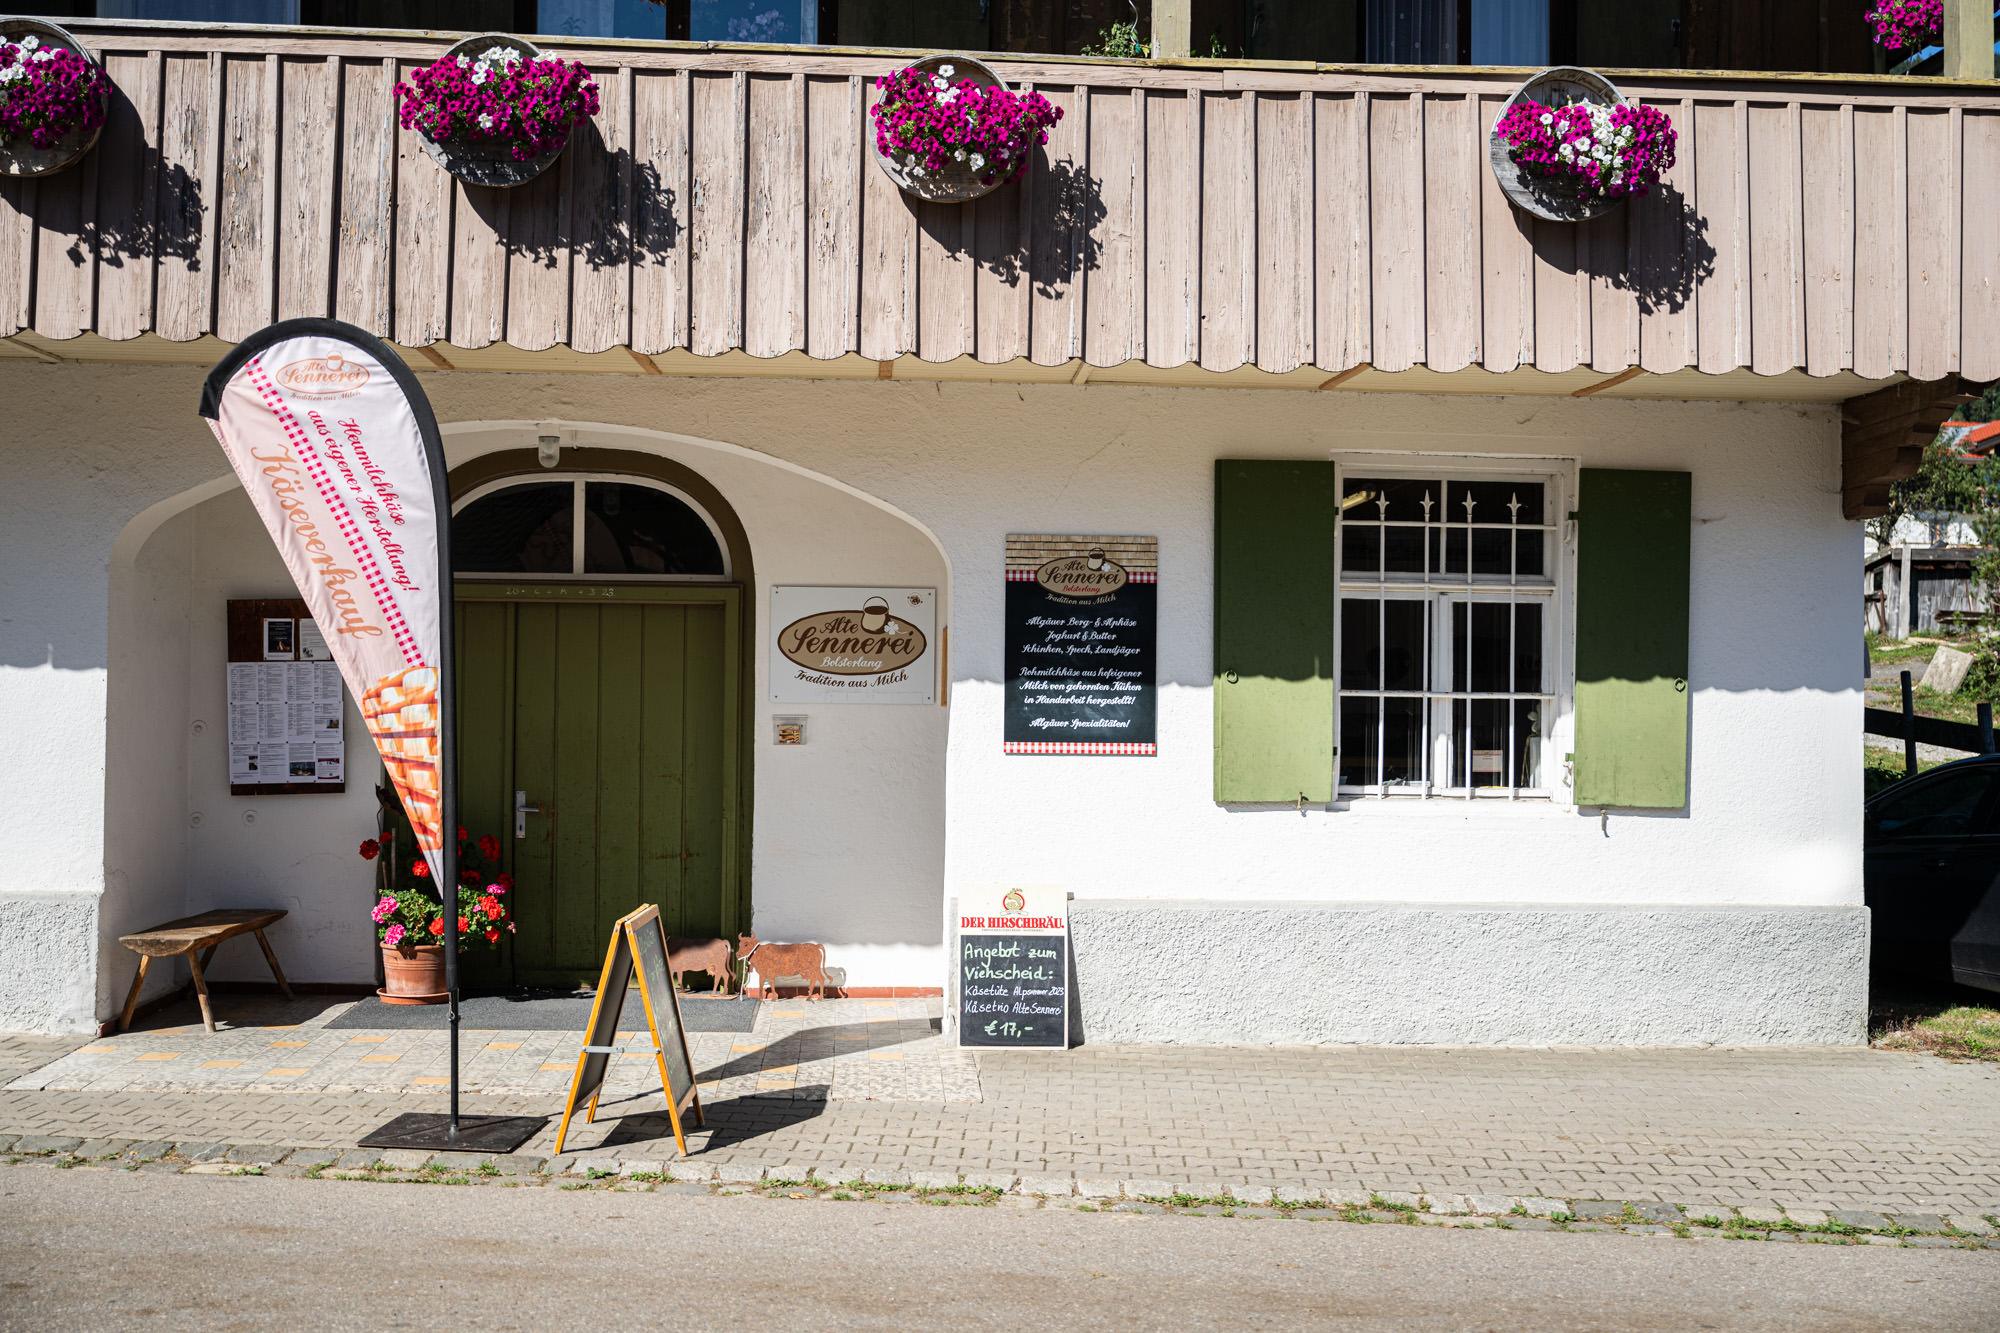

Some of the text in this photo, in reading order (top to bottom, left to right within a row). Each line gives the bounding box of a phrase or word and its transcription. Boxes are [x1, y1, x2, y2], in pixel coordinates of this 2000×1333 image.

[284, 366, 361, 384] Sennerei
[338, 417, 405, 526] Heumilchkäse
[307, 410, 421, 591] aus eigener Herstellung!
[250, 443, 384, 640] Käseverkauf
[1060, 560, 1086, 572] Alte
[1041, 566, 1120, 585] Sennerei
[1045, 592, 1077, 605] Tradition
[1092, 593, 1117, 605] Milch
[820, 616, 859, 634] Alte
[788, 626, 915, 655] Sennerei
[1045, 630, 1117, 642] Joghurt & Butter
[1021, 643, 1141, 656] Schinken, Speck, Landjäger
[819, 655, 884, 670] Bolsterlang
[793, 669, 909, 688] Tradition aus Milch
[1019, 666, 1080, 677] Rohmilchkäse
[1097, 667, 1142, 680] hofeigener
[1019, 680, 1049, 691] Milch
[1110, 681, 1142, 692] Kühen
[1024, 694, 1136, 707] in Handarbeit hergestellt!
[1070, 718, 1131, 730] Spezialitäten!
[960, 917, 986, 929] DER
[964, 940, 1057, 969] Angebot zum
[964, 963, 1054, 981] Viehscheid:
[965, 984, 1009, 997] Käsetüte
[965, 1000, 1063, 1016] Käsetrio Alte Sennerei
